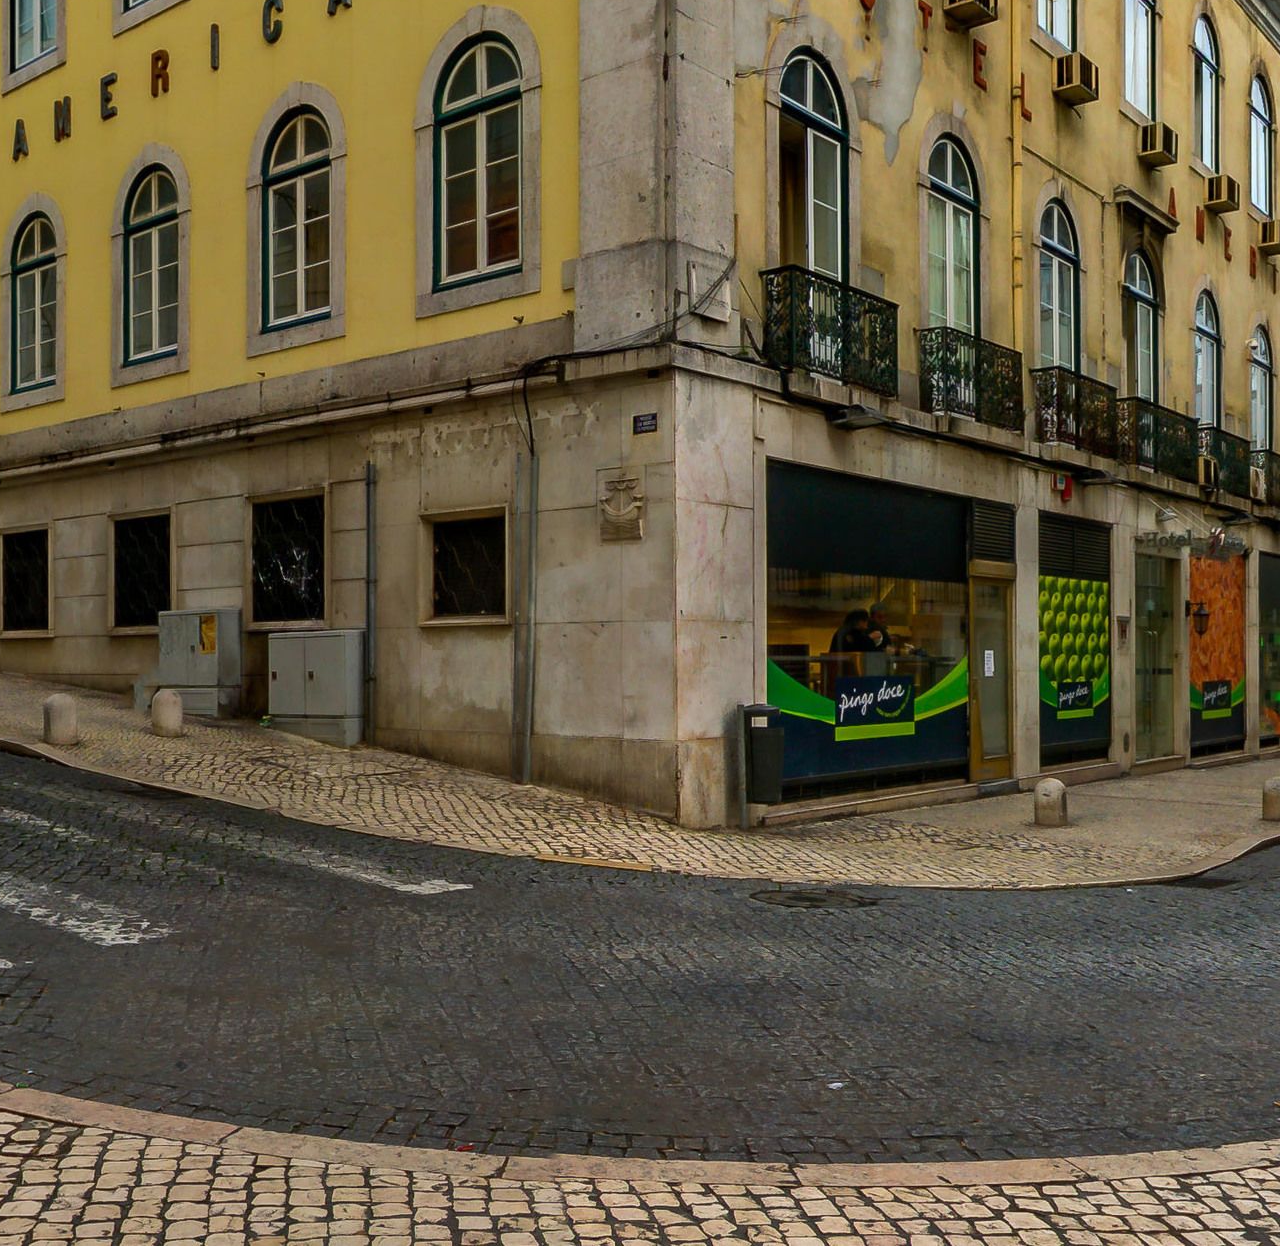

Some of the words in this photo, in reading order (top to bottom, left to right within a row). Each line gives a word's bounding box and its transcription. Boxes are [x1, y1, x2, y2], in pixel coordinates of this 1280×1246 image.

[1143, 528, 1192, 548] Hotel
[838, 687, 874, 723] pingo
[876, 679, 905, 703] doce
